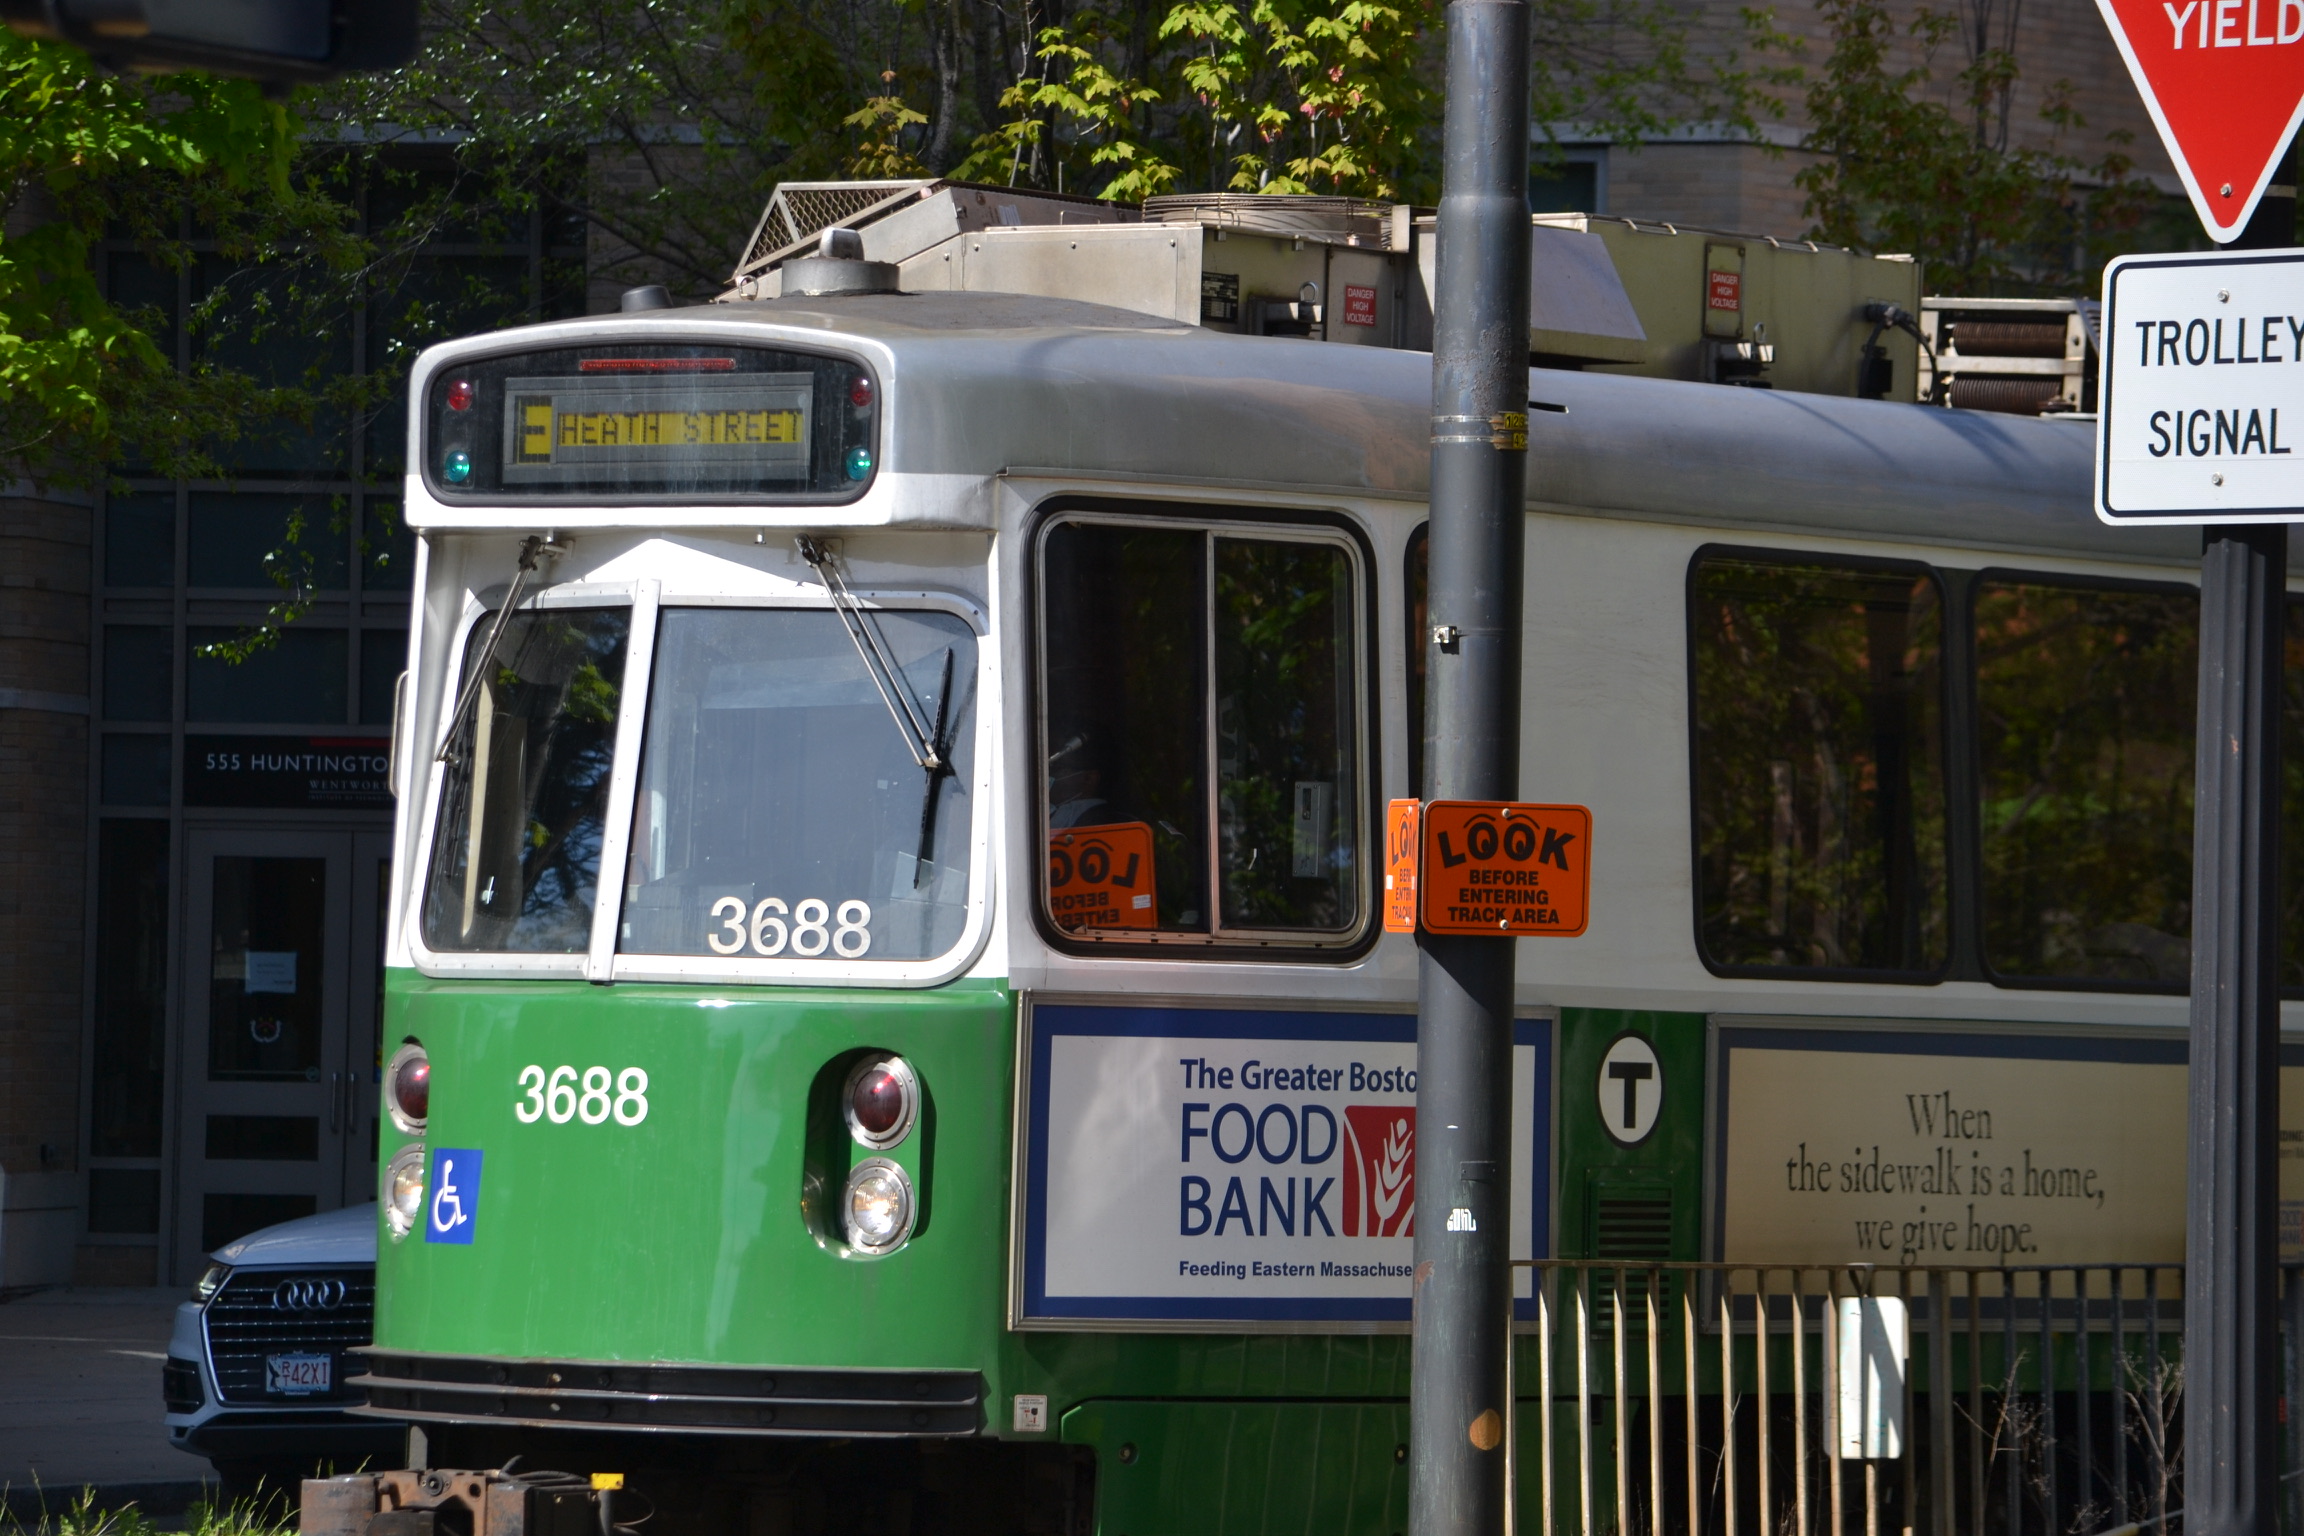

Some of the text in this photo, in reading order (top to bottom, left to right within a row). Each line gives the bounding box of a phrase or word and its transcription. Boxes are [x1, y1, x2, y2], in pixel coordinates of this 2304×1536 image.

[2163, 0, 2304, 49] YIELD
[1347, 288, 1375, 300] DANGER
[1712, 273, 1738, 285] DANGER
[1717, 286, 1733, 297] HIGH
[1346, 312, 1374, 325] VOLTAGE
[1352, 301, 1369, 311] HIGH
[1711, 297, 1738, 309] VOLTAGE
[2135, 316, 2304, 367] TROLLEY
[561, 412, 659, 444] HEATH
[684, 409, 803, 442] STREET
[2148, 408, 2291, 458] SIGNAL
[206, 753, 388, 773] 555 HUNTINGTO
[1437, 821, 1576, 872] LOOK
[1469, 869, 1539, 886] BEFORE
[1459, 888, 1549, 906] ENTERING
[708, 896, 872, 958] 3688
[1448, 907, 1560, 924] TRACK AREA
[1180, 1058, 1234, 1089] The
[1241, 1060, 1344, 1092] Greater
[515, 1064, 650, 1127] 3688
[1608, 1061, 1653, 1129] T
[1906, 1090, 1993, 1139] When
[1180, 1102, 1338, 1165] FOOD
[1786, 1142, 2105, 1209] the sidewalk is a home,
[1180, 1174, 1336, 1238] BANK
[1855, 1203, 2038, 1266] we give hope.
[1179, 1261, 1413, 1280] Feeding Eastern Massachuse
